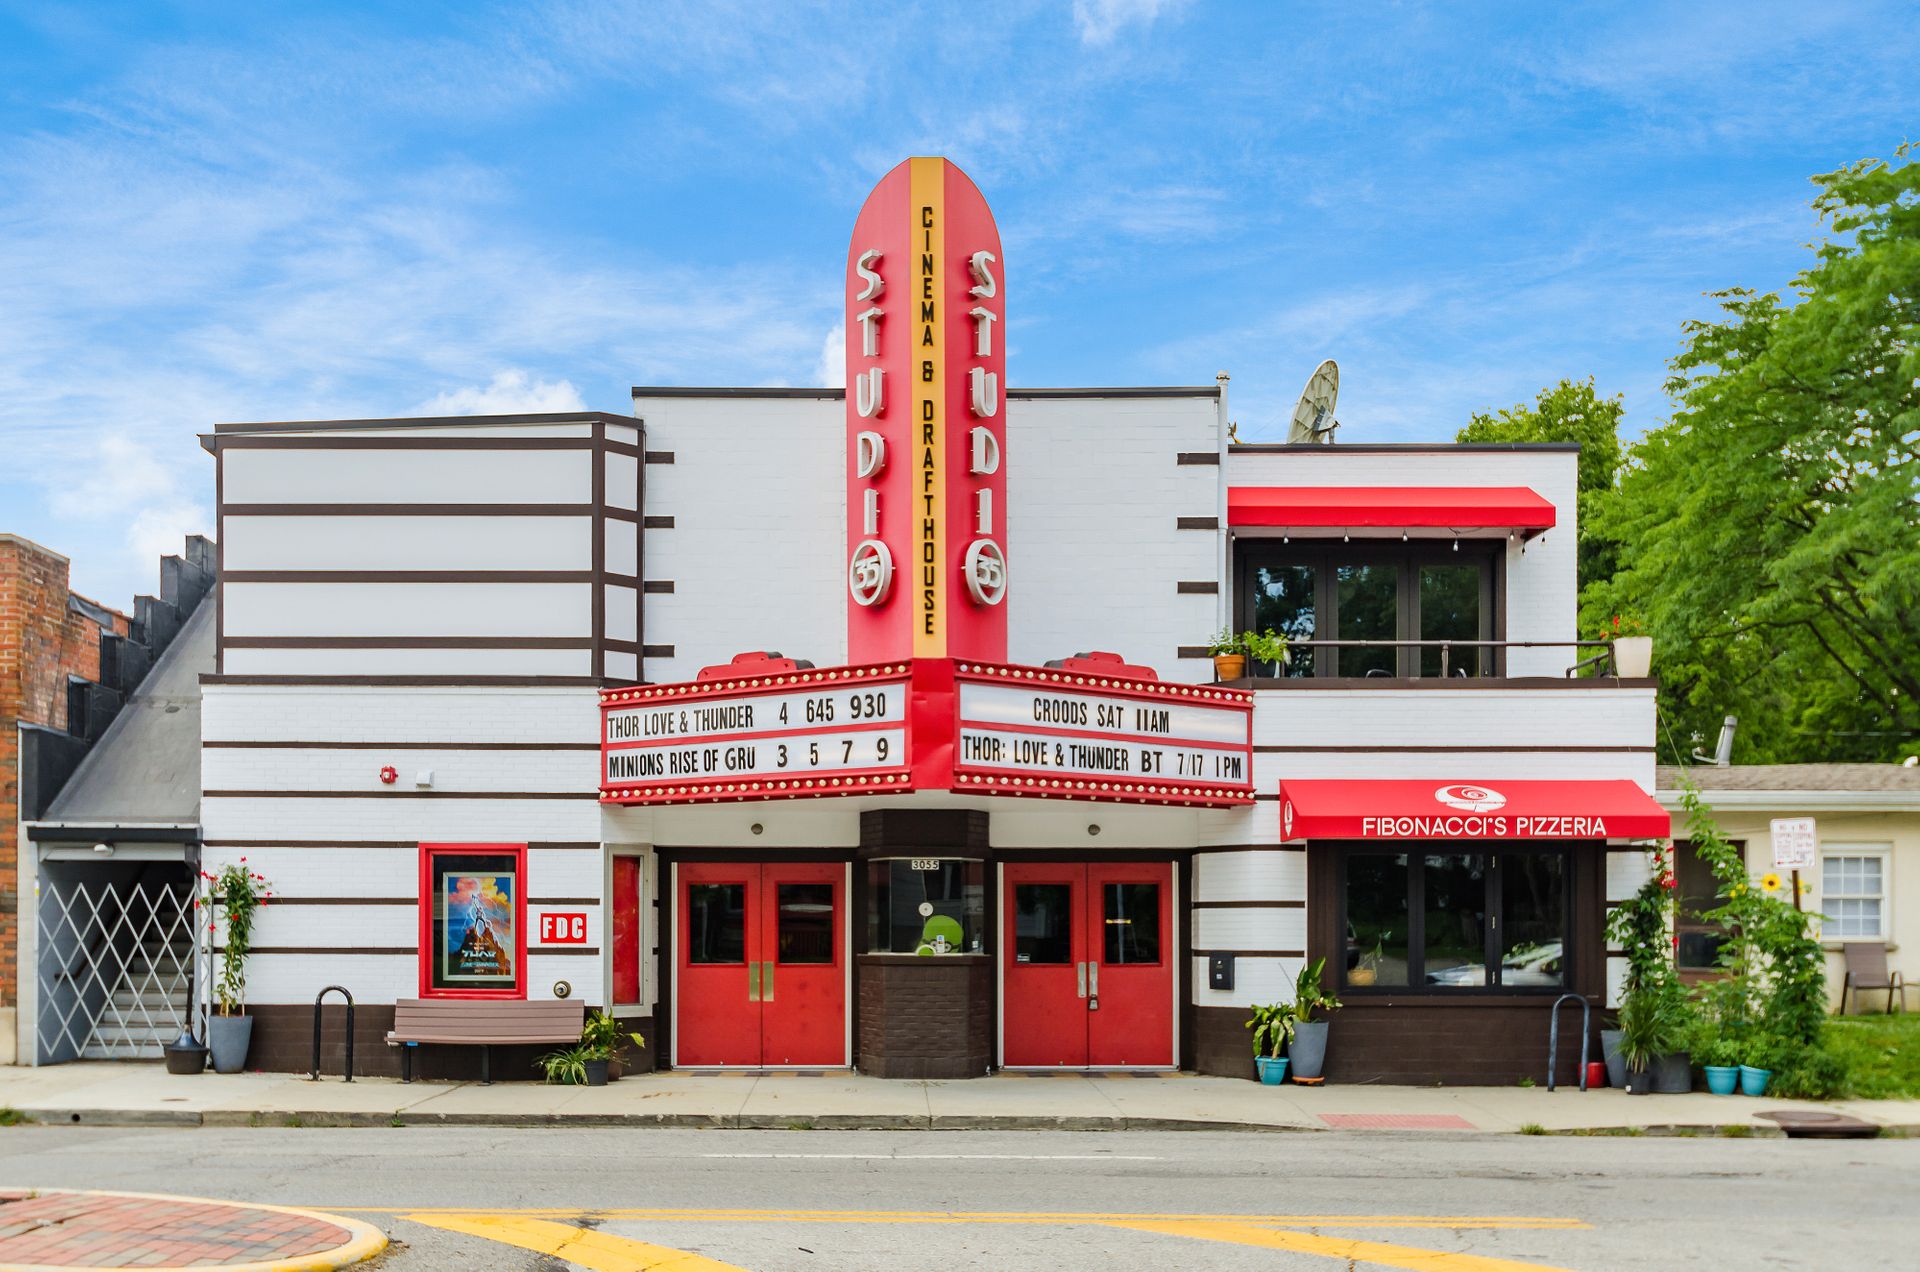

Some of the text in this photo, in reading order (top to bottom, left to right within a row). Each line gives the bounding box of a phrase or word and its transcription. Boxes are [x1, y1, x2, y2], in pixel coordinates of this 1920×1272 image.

[850, 249, 893, 606] STUDIO
[922, 206, 934, 634] CINEMA & DRAFTHOUSE
[965, 250, 1007, 605] STUDIO
[855, 554, 879, 590] 35
[977, 554, 1001, 588] 35
[607, 692, 886, 739] THOR LOVE & THUNDER 4 645 930
[1033, 697, 1088, 726] CROODS
[1097, 705, 1124, 729] SAT
[609, 737, 889, 778] MINIONS RISE OF GRU 3 5 7 9
[962, 735, 1006, 761] THOR:
[1014, 739, 1048, 765] LOVE
[1055, 745, 1064, 767] &
[1069, 744, 1129, 771] THUNDER
[1141, 751, 1163, 773] BT
[1177, 752, 1203, 776] 7/17
[1362, 816, 1607, 836] FIBONACCI'S PIZZERIA
[913, 861, 939, 869] 3055
[542, 917, 584, 939] FDC
